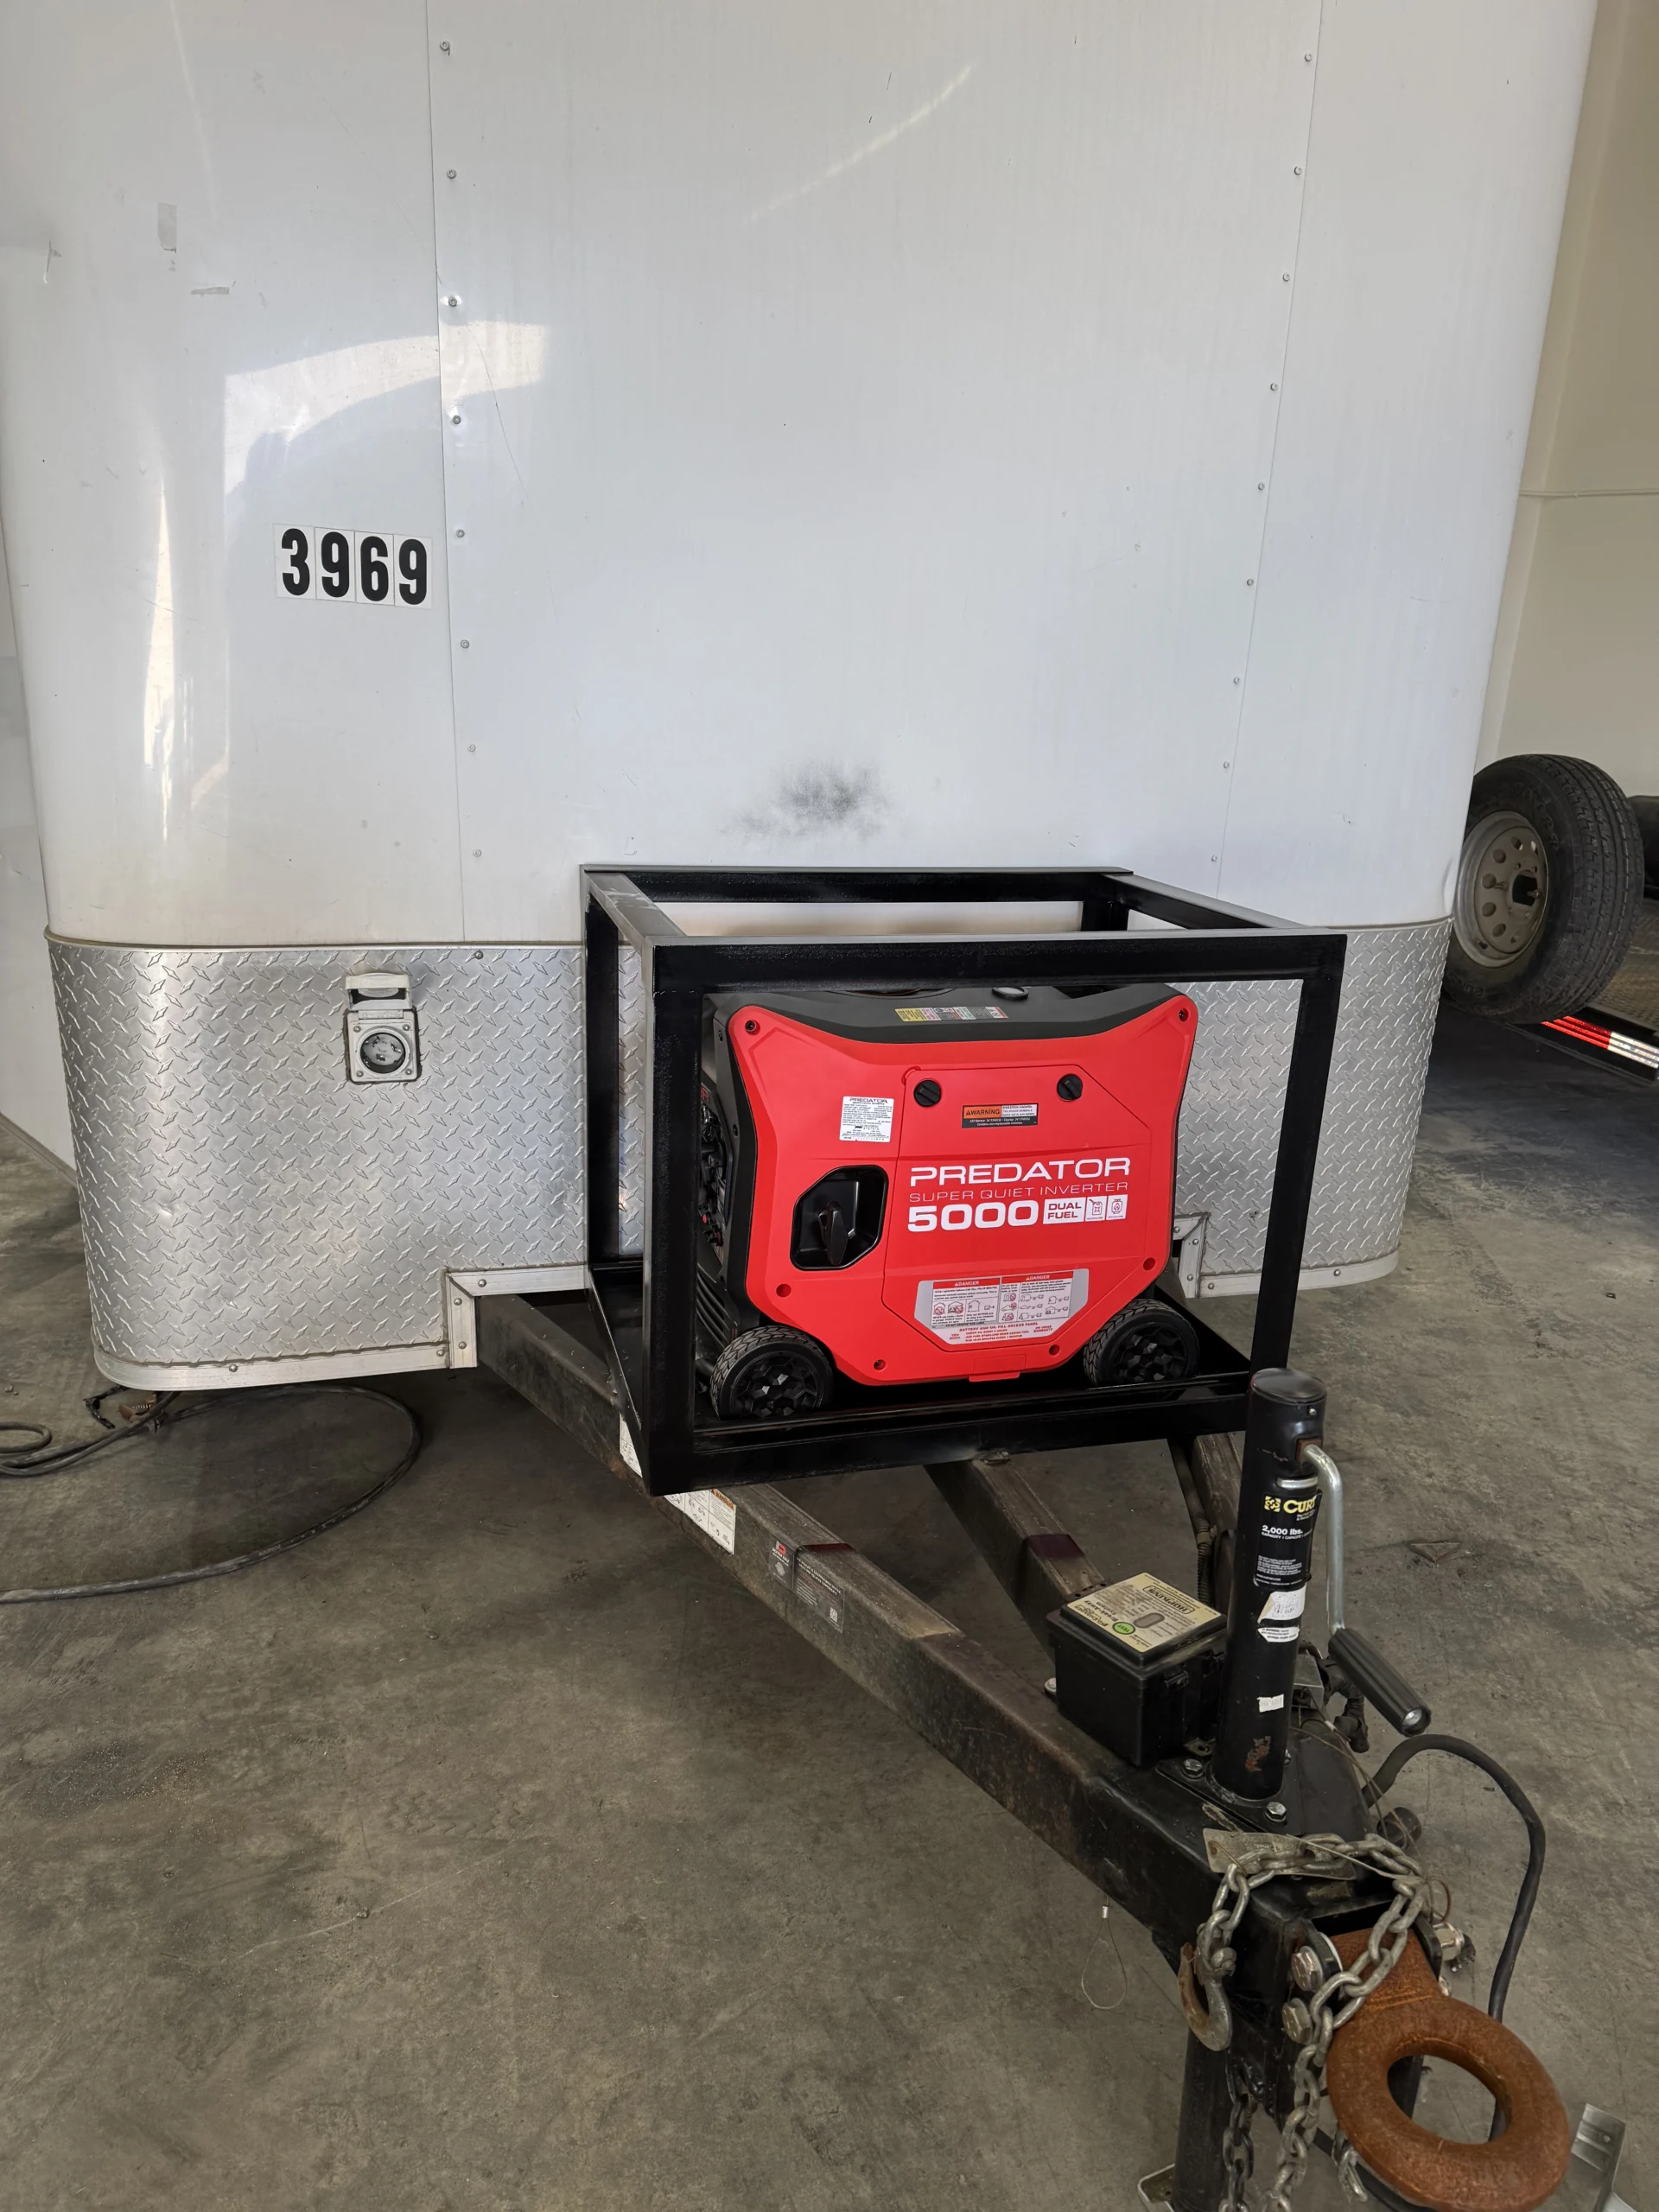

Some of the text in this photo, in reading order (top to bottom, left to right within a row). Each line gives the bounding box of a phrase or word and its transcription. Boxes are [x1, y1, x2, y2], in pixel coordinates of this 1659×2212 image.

[282, 528, 427, 605] 3969
[910, 1157, 1131, 1187] PREDATOR
[909, 1181, 1128, 1203] SUPER QUIET INVERTER
[907, 1200, 1039, 1233] 5000
[1047, 1211, 1078, 1220] FUEL
[1048, 1201, 1082, 1211] DUAL
[1262, 1524, 1287, 1535] 2,000
[1084, 1599, 1118, 1623] Break-Away
[1096, 1601, 1118, 1616] System
[1148, 1588, 1190, 1613] HOPKINS
[1117, 1624, 1130, 1633] TEST
